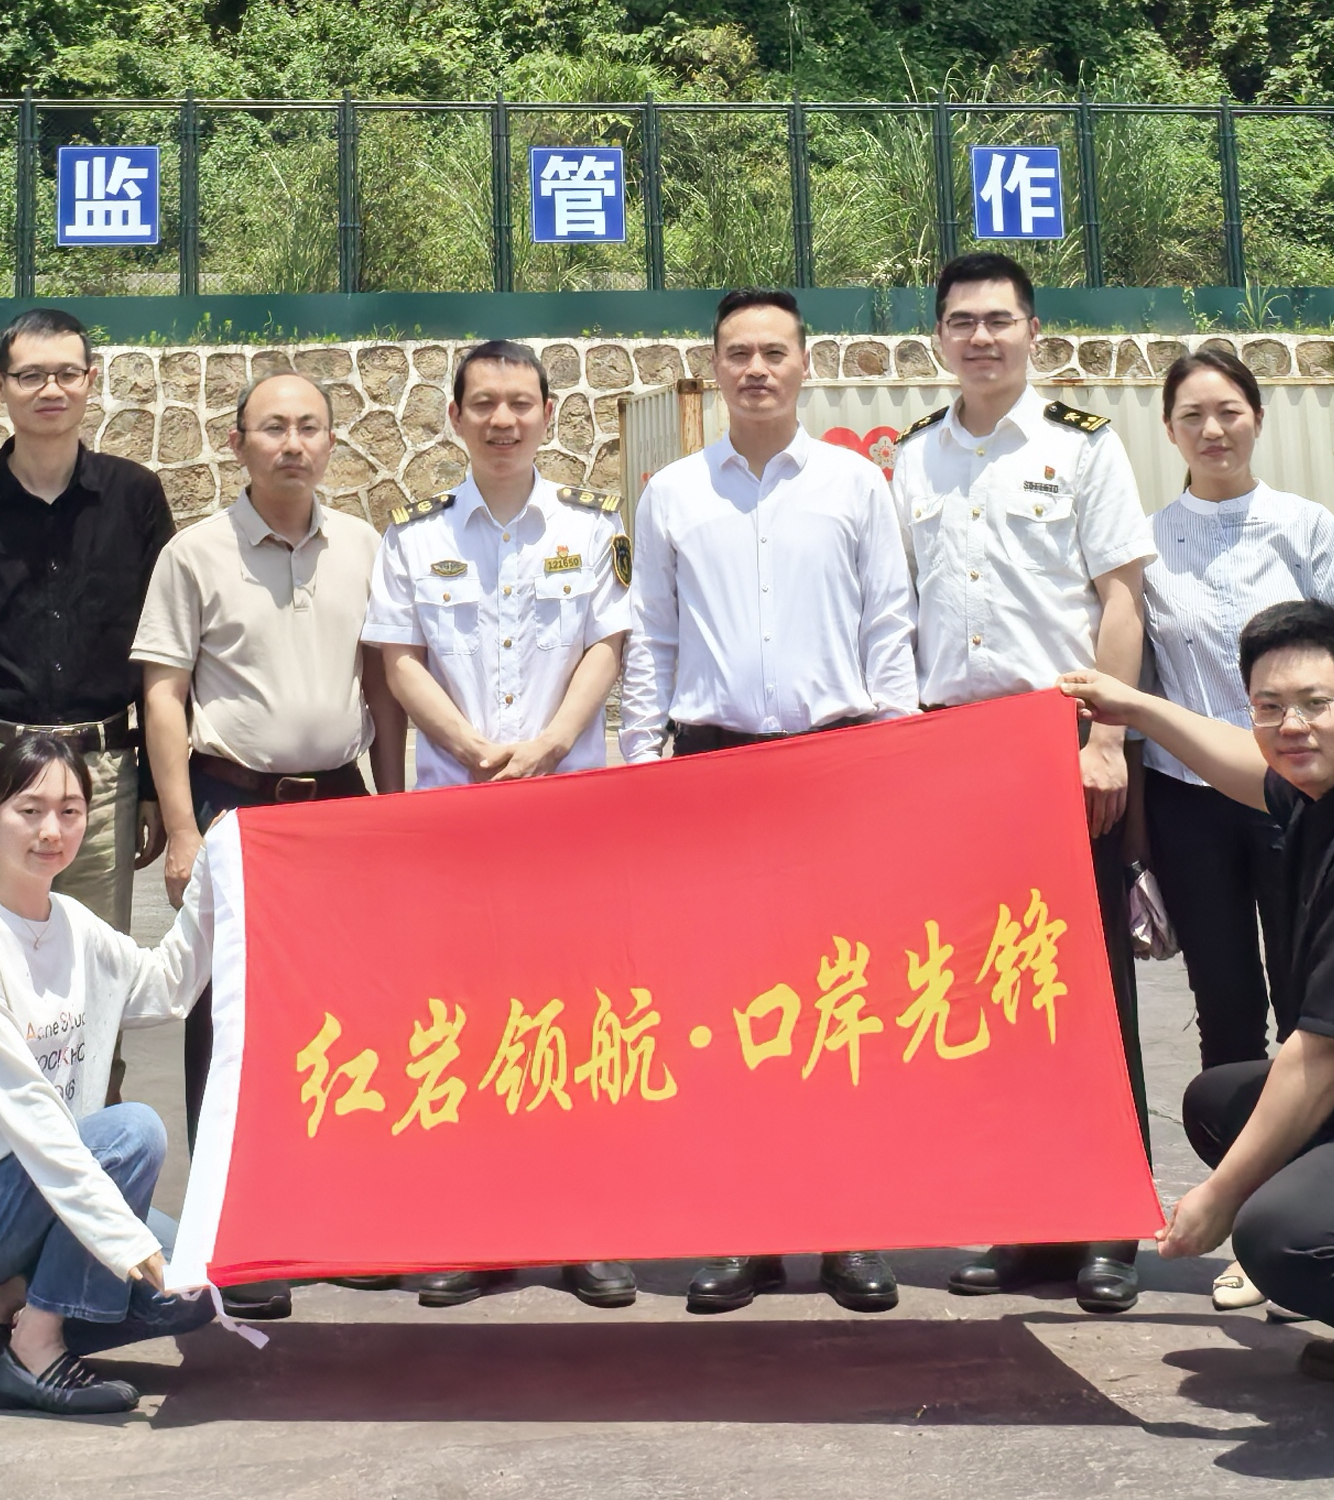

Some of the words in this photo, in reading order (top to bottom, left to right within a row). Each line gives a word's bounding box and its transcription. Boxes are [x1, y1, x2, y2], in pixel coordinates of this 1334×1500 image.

[65, 155, 151, 237] 监
[540, 154, 616, 236] 管
[980, 153, 1056, 234] 作
